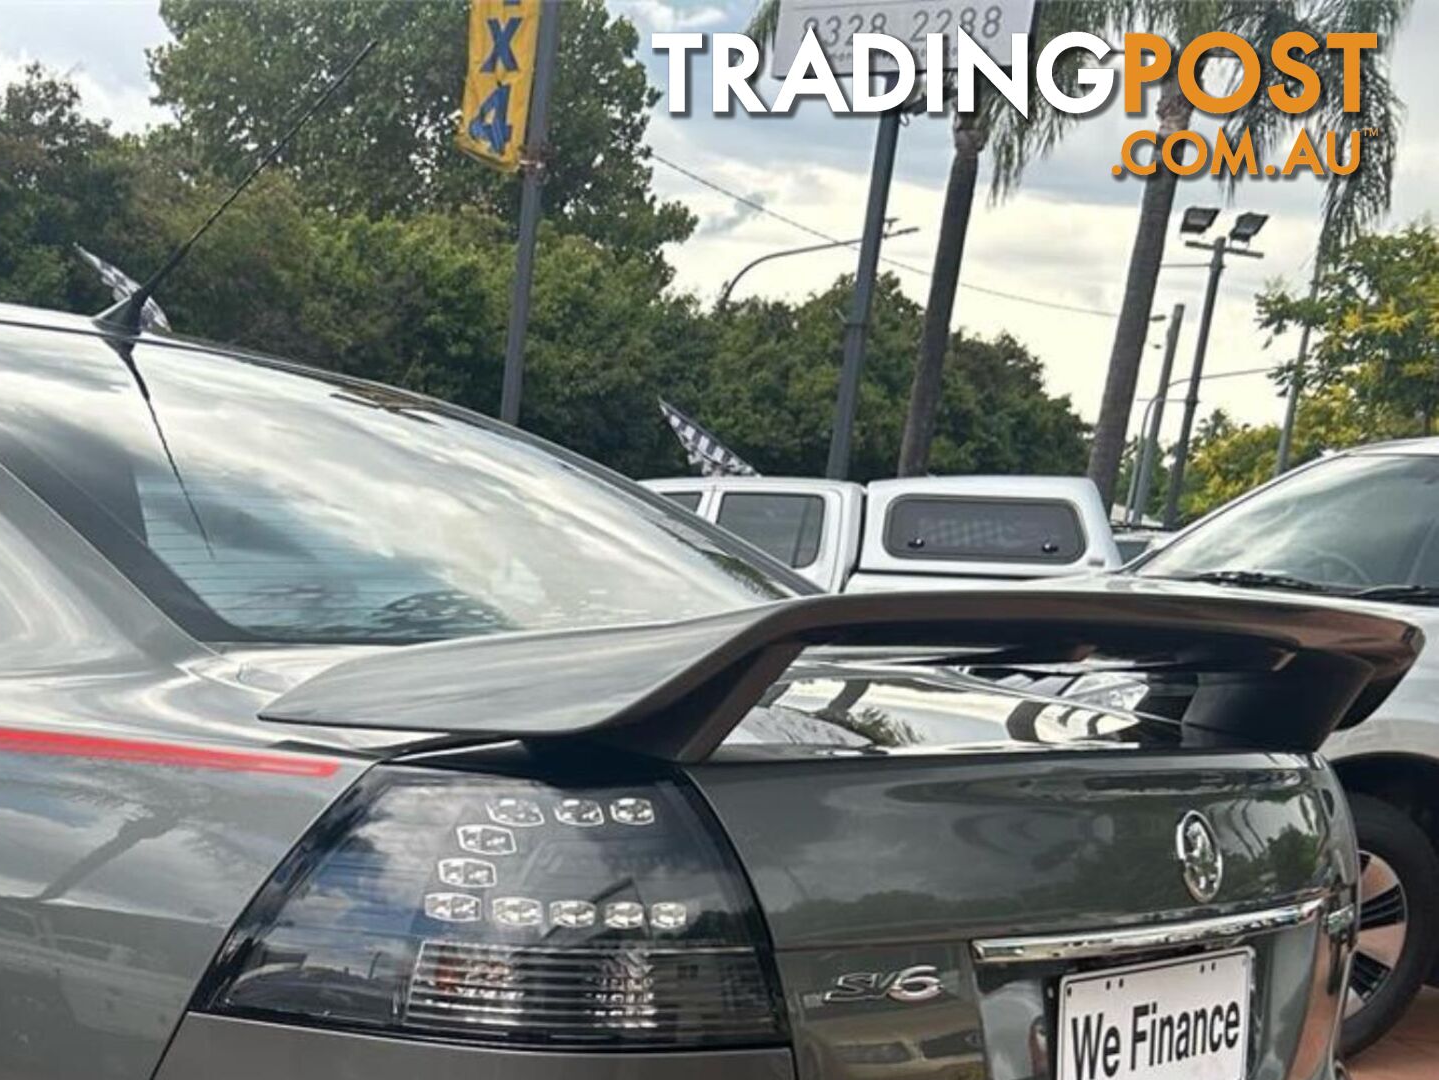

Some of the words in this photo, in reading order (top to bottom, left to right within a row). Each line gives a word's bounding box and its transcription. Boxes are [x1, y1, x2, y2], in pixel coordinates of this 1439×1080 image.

[911, 5, 1002, 42] 2288
[471, 0, 522, 155] X4
[823, 965, 943, 1003] SV6
[1130, 1001, 1240, 1071] Finance
